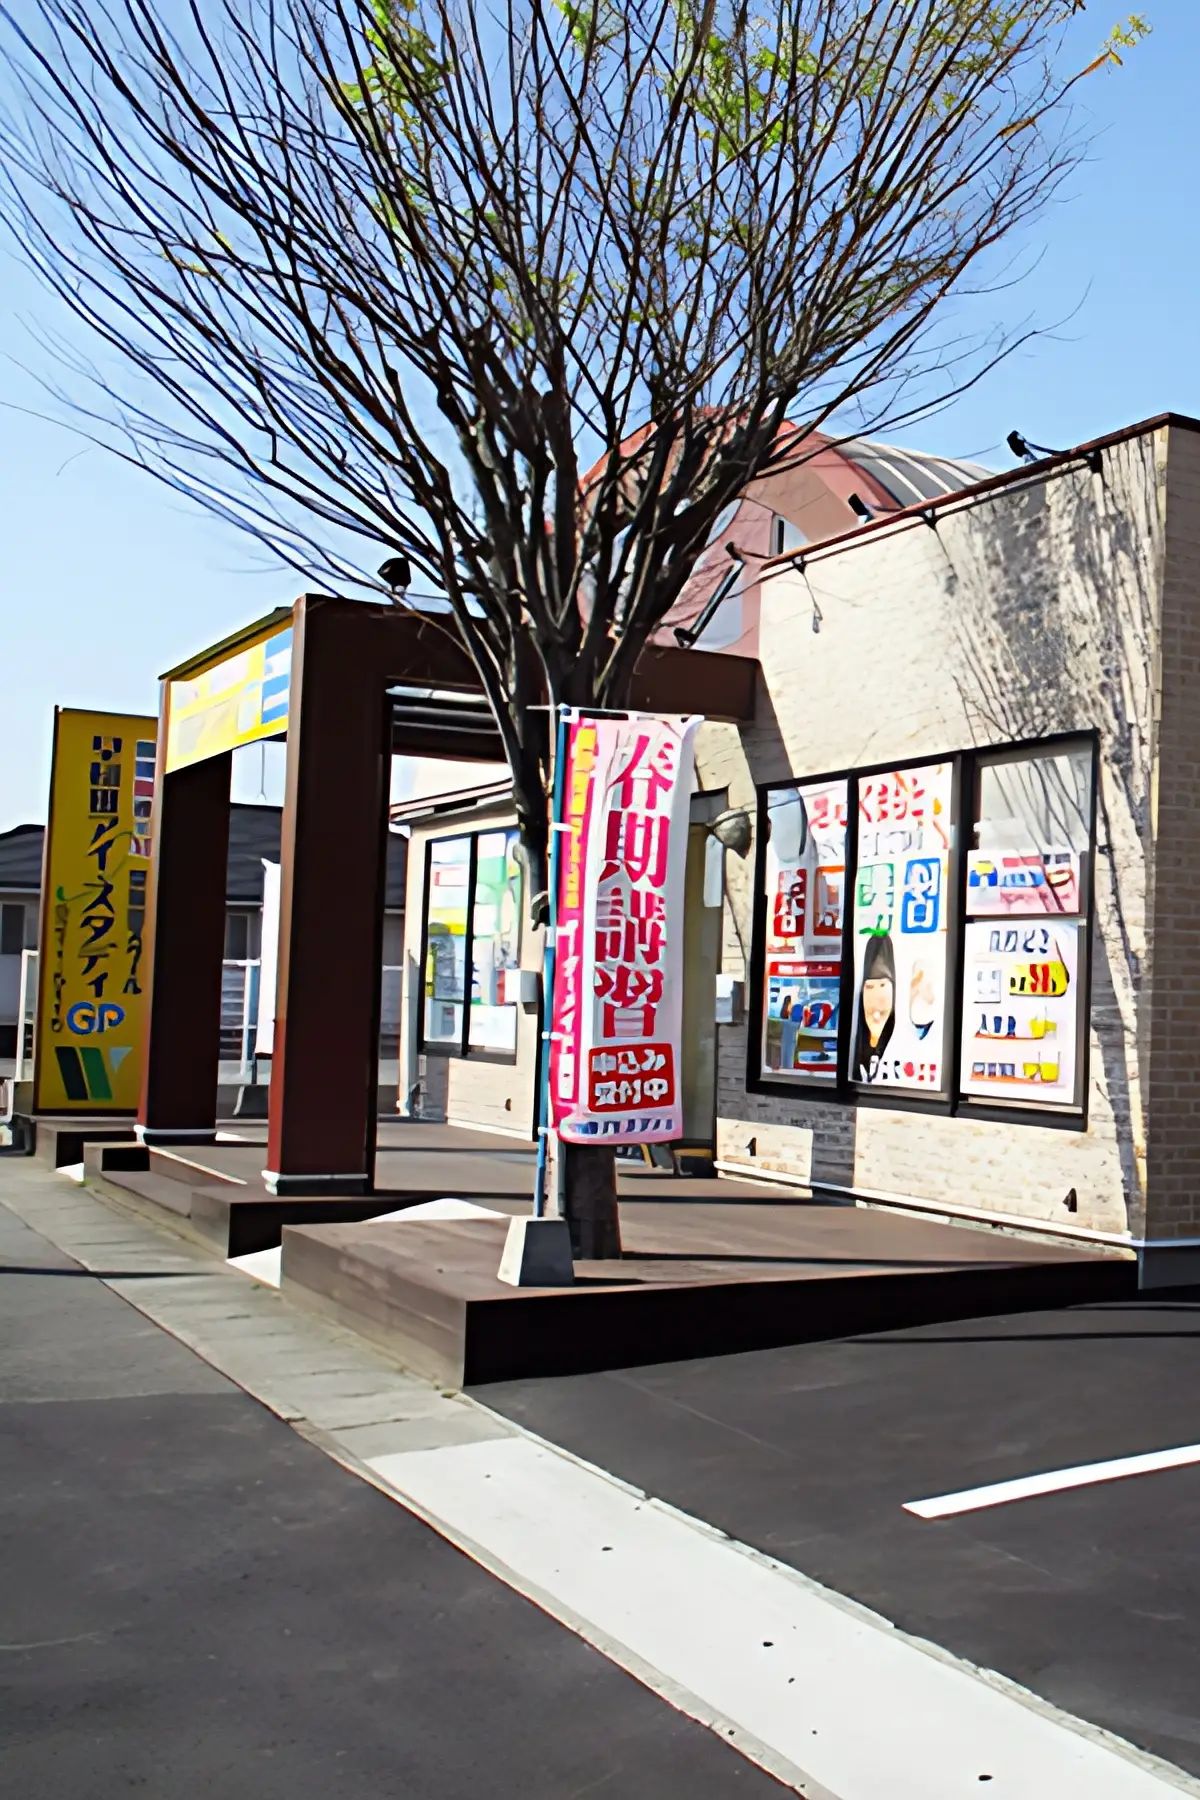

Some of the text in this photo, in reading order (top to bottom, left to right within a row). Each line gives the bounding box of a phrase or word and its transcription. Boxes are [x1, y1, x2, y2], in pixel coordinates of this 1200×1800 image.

[593, 734, 674, 1038] 春期講習
[66, 1001, 125, 1035] GP
